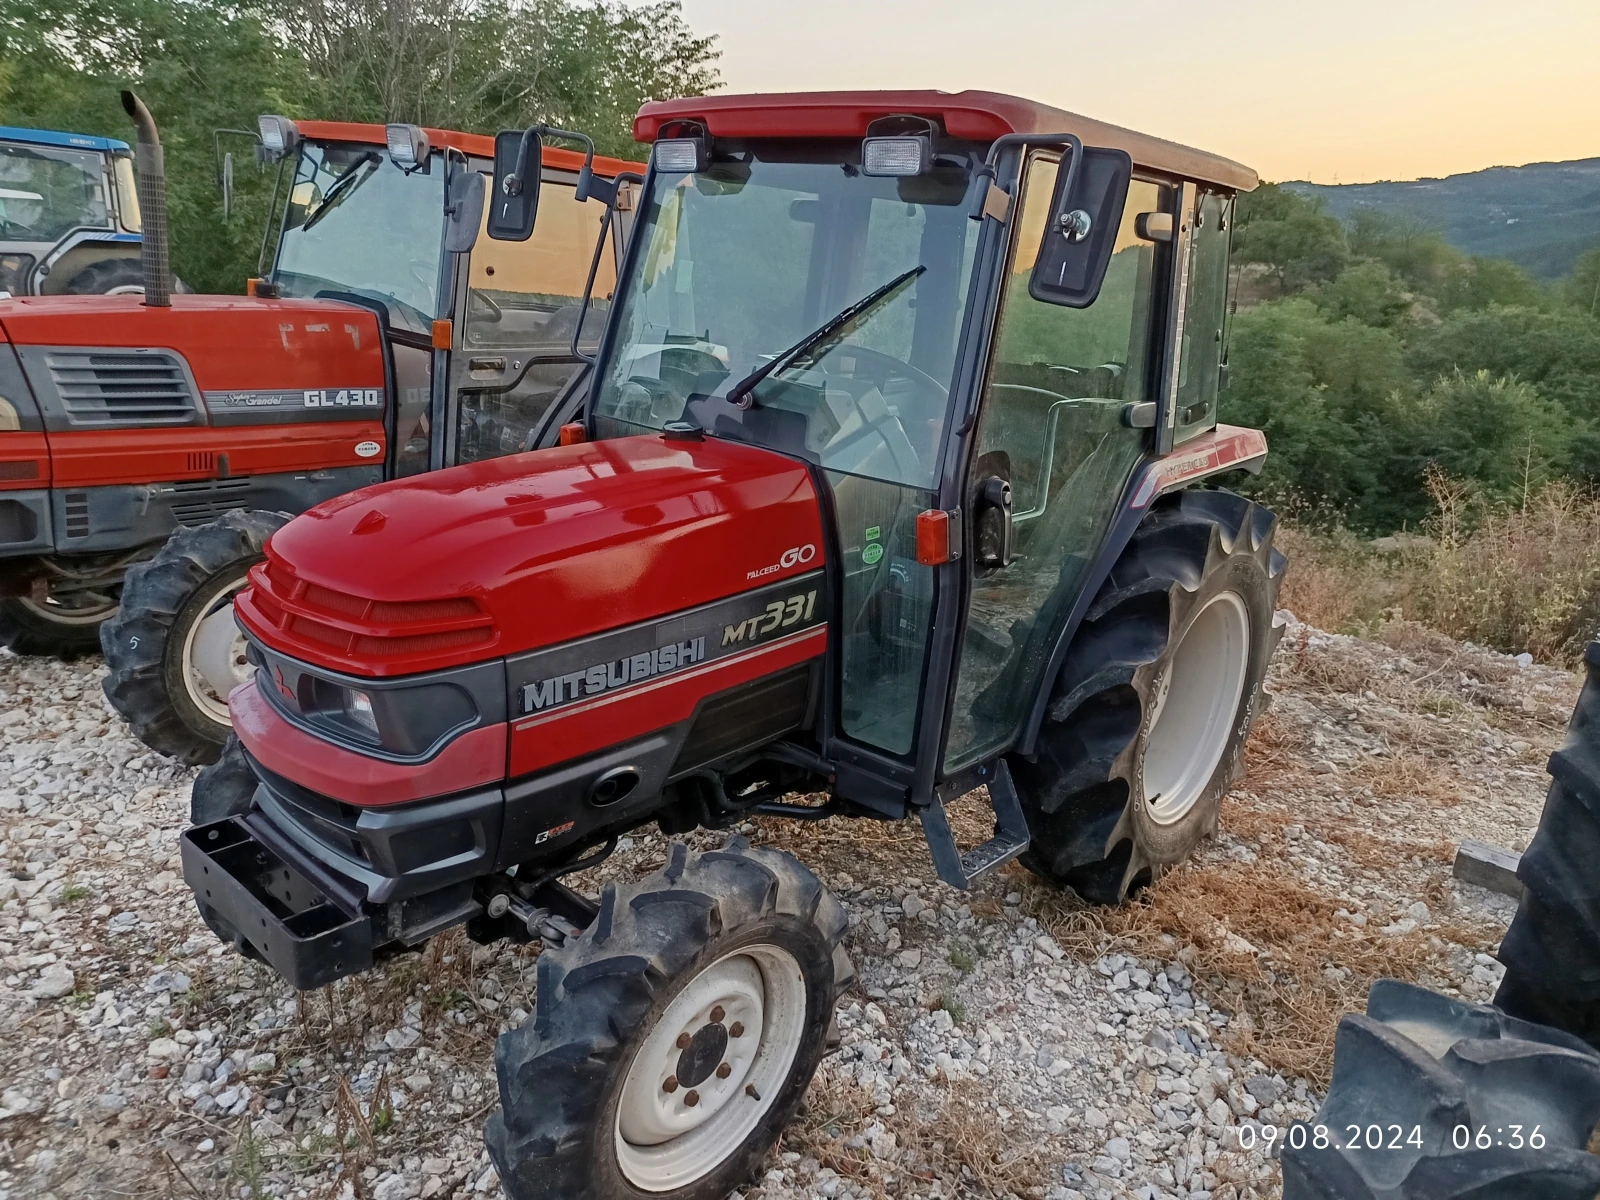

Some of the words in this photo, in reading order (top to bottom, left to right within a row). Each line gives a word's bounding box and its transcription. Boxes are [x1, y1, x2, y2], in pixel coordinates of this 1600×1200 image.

[304, 390, 378, 407] GL430
[747, 564, 780, 580] PALCEED
[780, 544, 816, 569] GO
[130, 636, 141, 650] 5
[522, 637, 705, 713] MITSUBISHI
[721, 590, 818, 649] MT331
